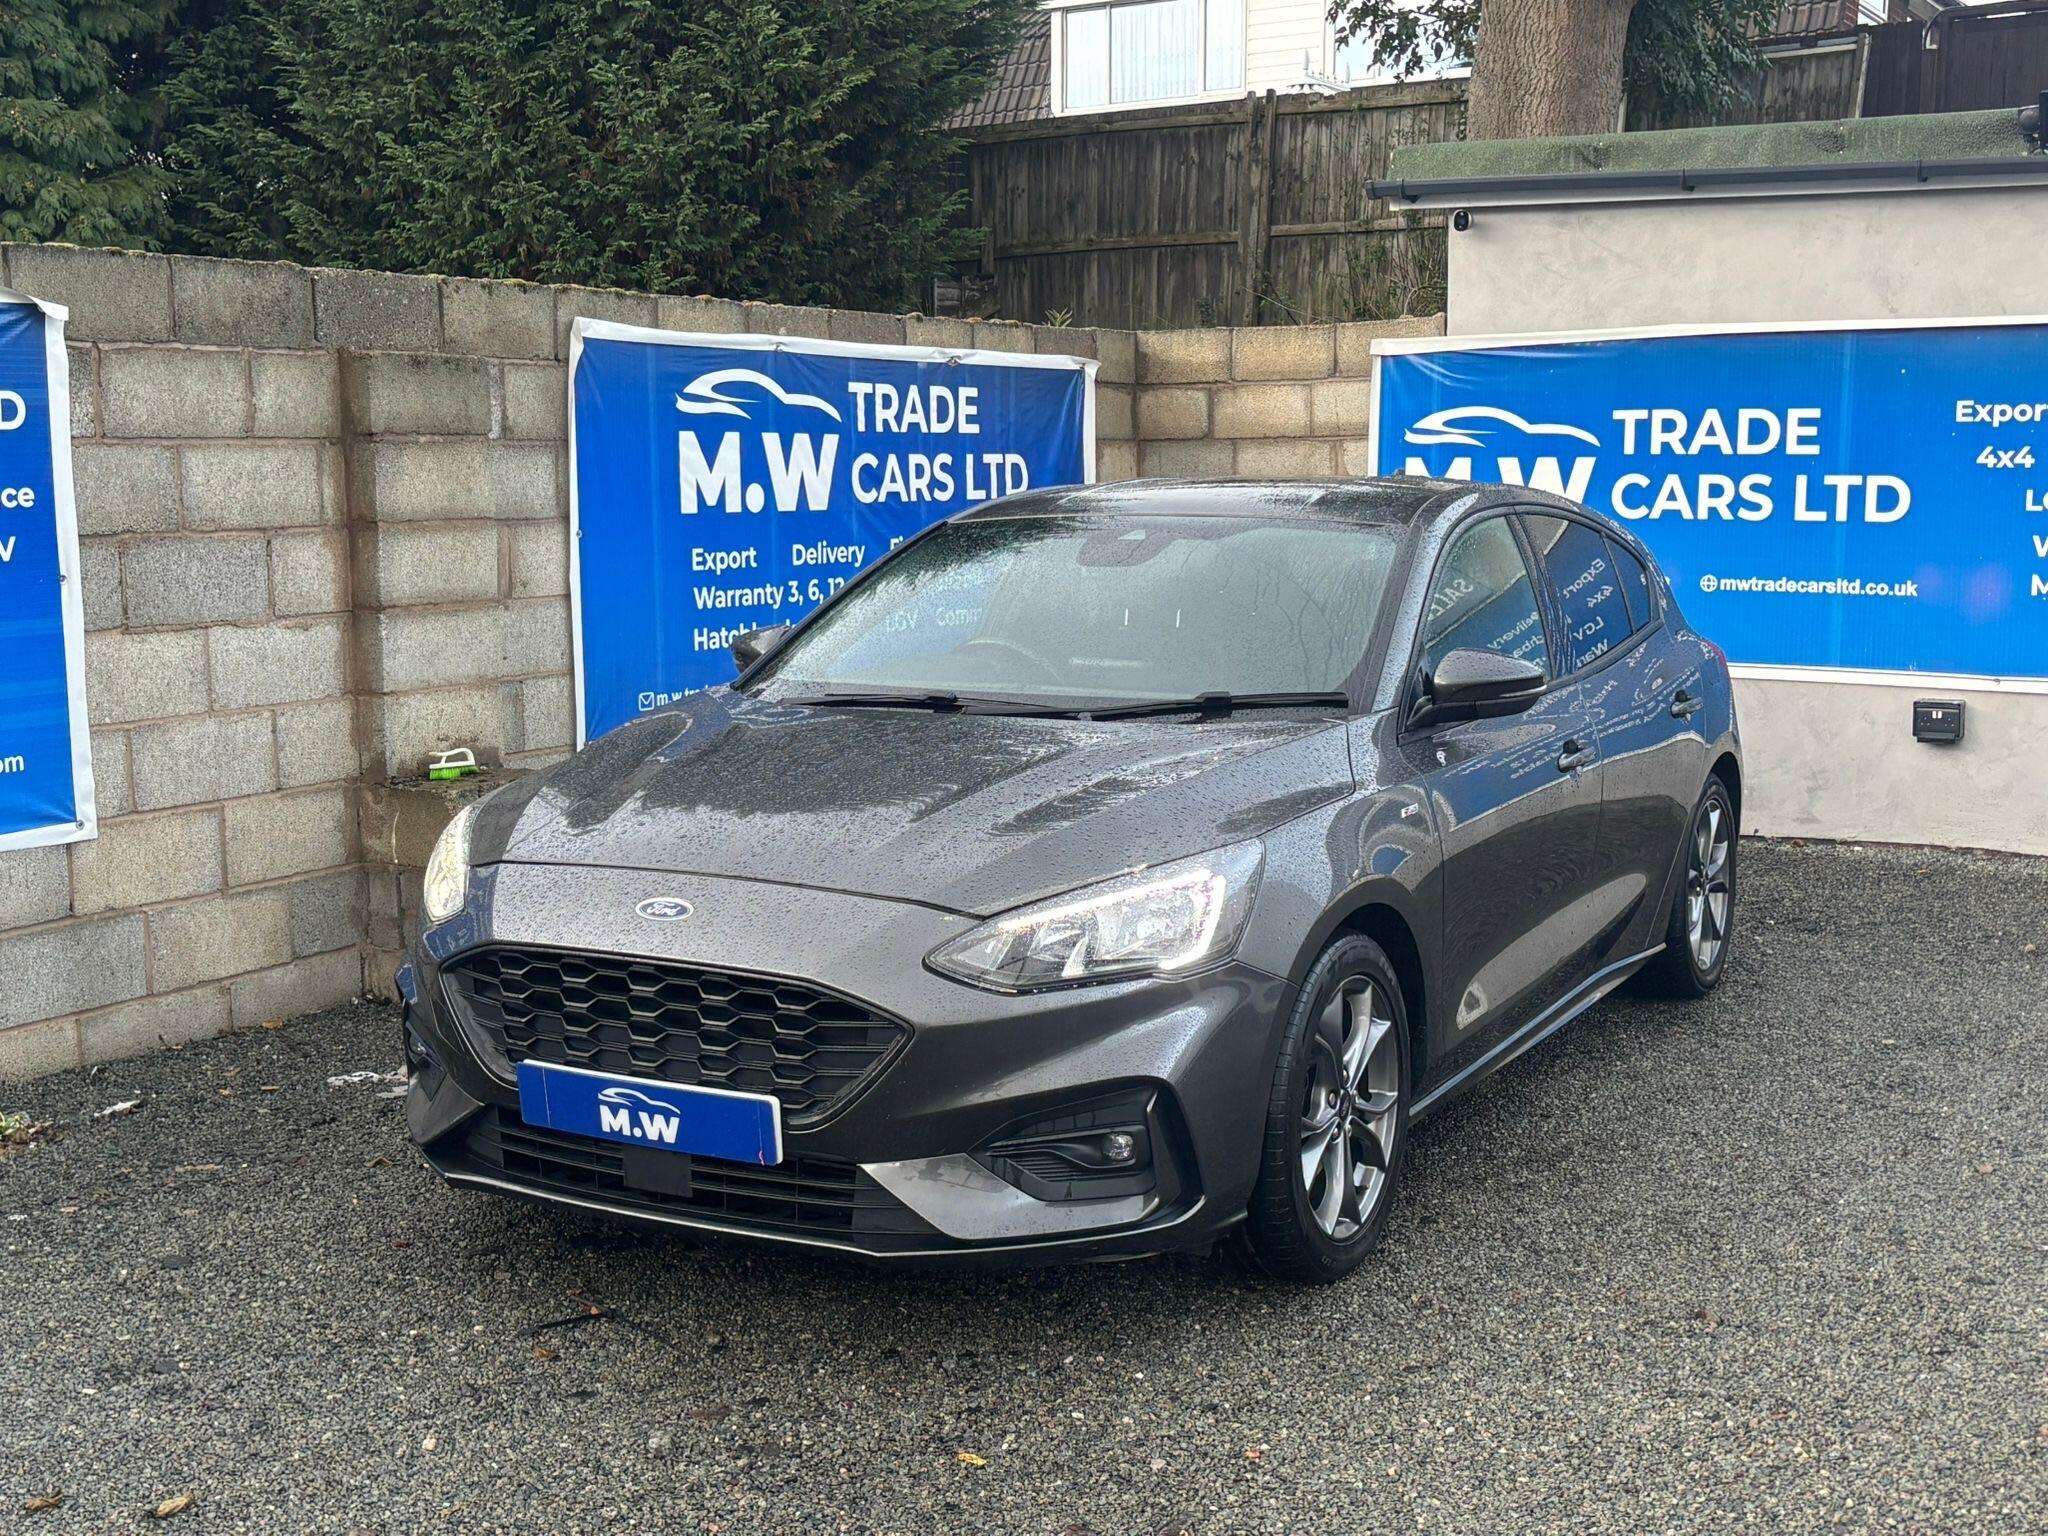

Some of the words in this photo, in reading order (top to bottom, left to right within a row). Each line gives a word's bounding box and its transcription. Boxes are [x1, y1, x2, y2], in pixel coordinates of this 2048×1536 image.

[848, 381, 980, 434] TRADE
[1955, 399, 2048, 428] Expor
[1612, 407, 1822, 456] TRADE
[678, 430, 840, 515] M.W
[1975, 445, 2036, 469] 4x4
[851, 453, 956, 505] CARS
[965, 452, 1029, 501] LTD
[1611, 473, 1776, 521] CARS
[1793, 473, 1912, 524] LTD
[691, 546, 758, 575] Export
[791, 539, 866, 568] Delivery
[693, 581, 785, 611] Warranty
[787, 580, 804, 606] 3,
[807, 578, 825, 603] 6,
[1719, 575, 1918, 599] mwtradecarsltd.co.uk
[599, 1104, 681, 1144] M.W
